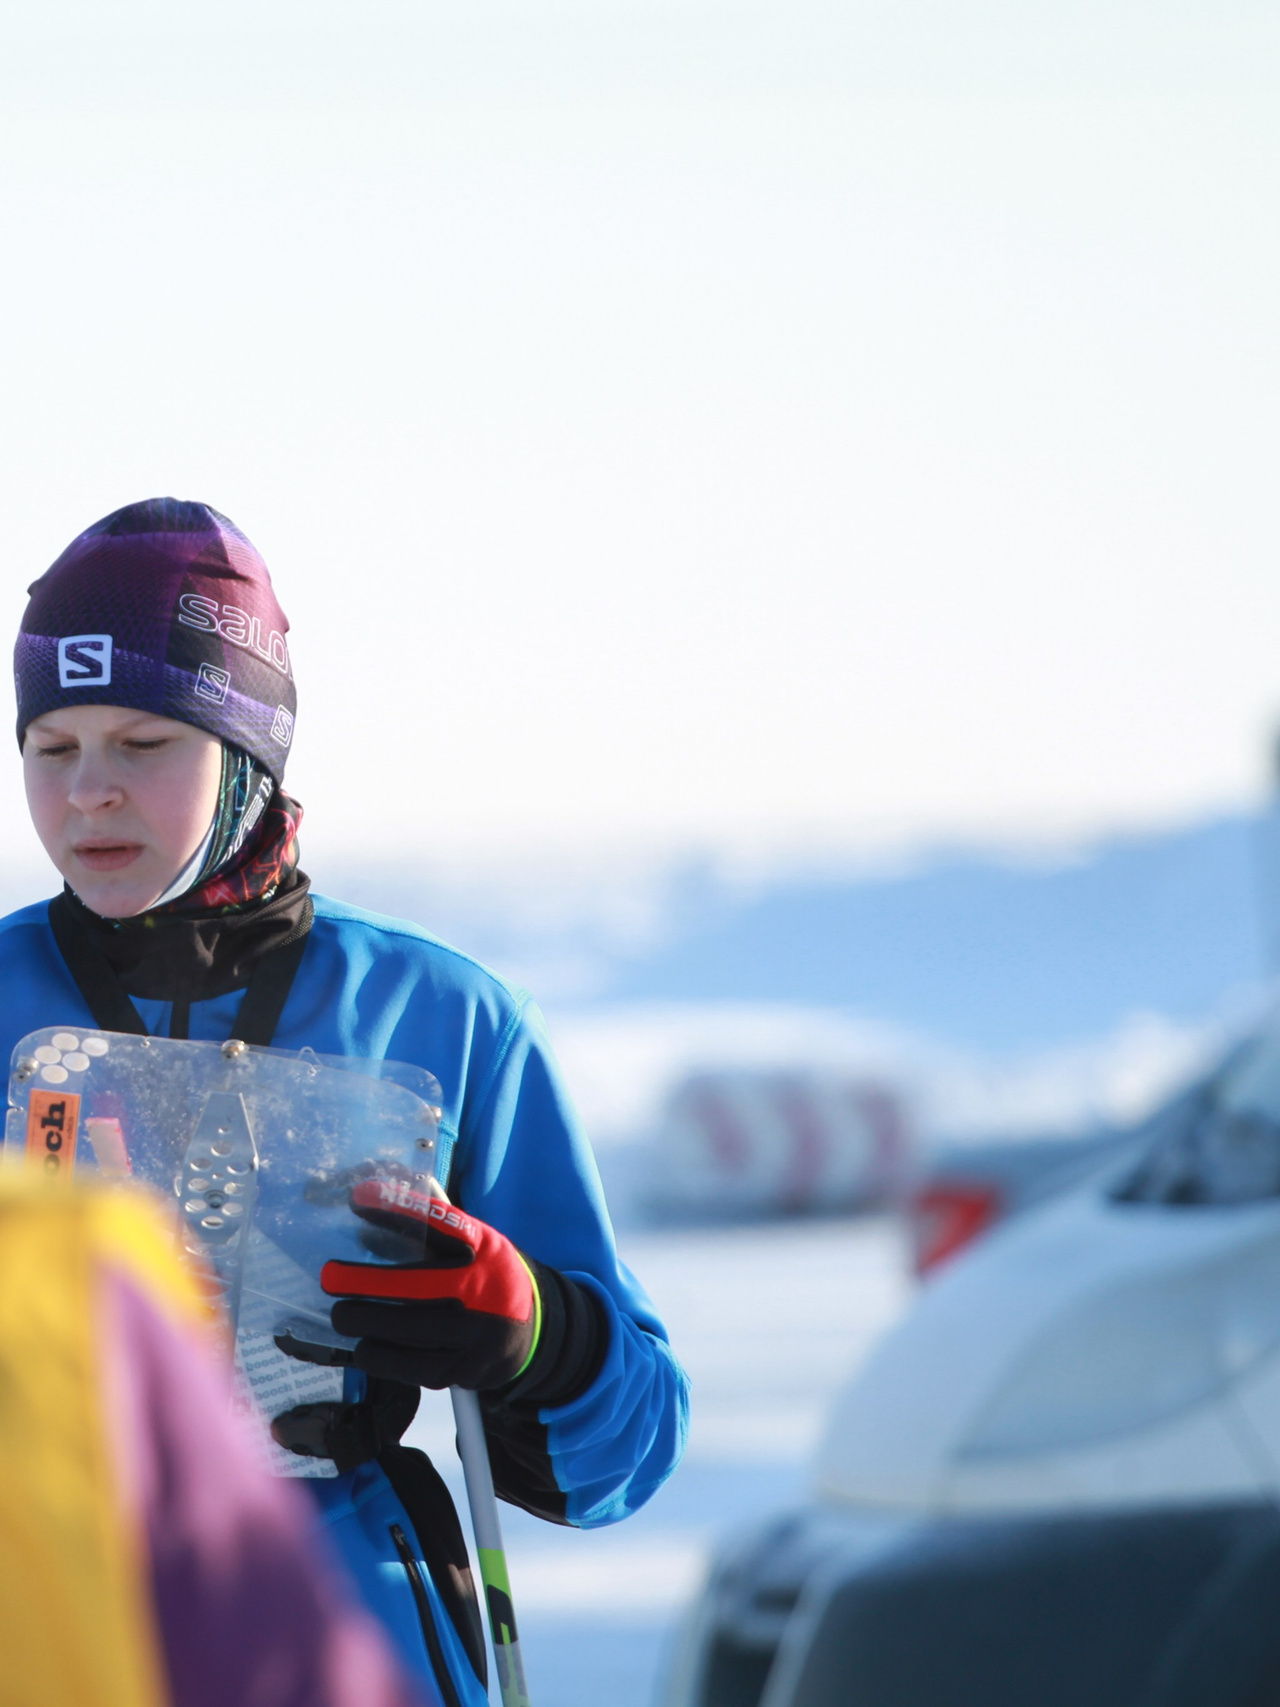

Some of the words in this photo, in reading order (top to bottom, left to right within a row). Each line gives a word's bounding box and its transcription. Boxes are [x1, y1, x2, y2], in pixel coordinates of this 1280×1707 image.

[179, 593, 293, 680] SALO
[63, 639, 107, 683] S
[198, 667, 227, 700] S
[41, 1101, 66, 1178] och
[249, 1367, 289, 1387] booch
[294, 1370, 333, 1389] booch
